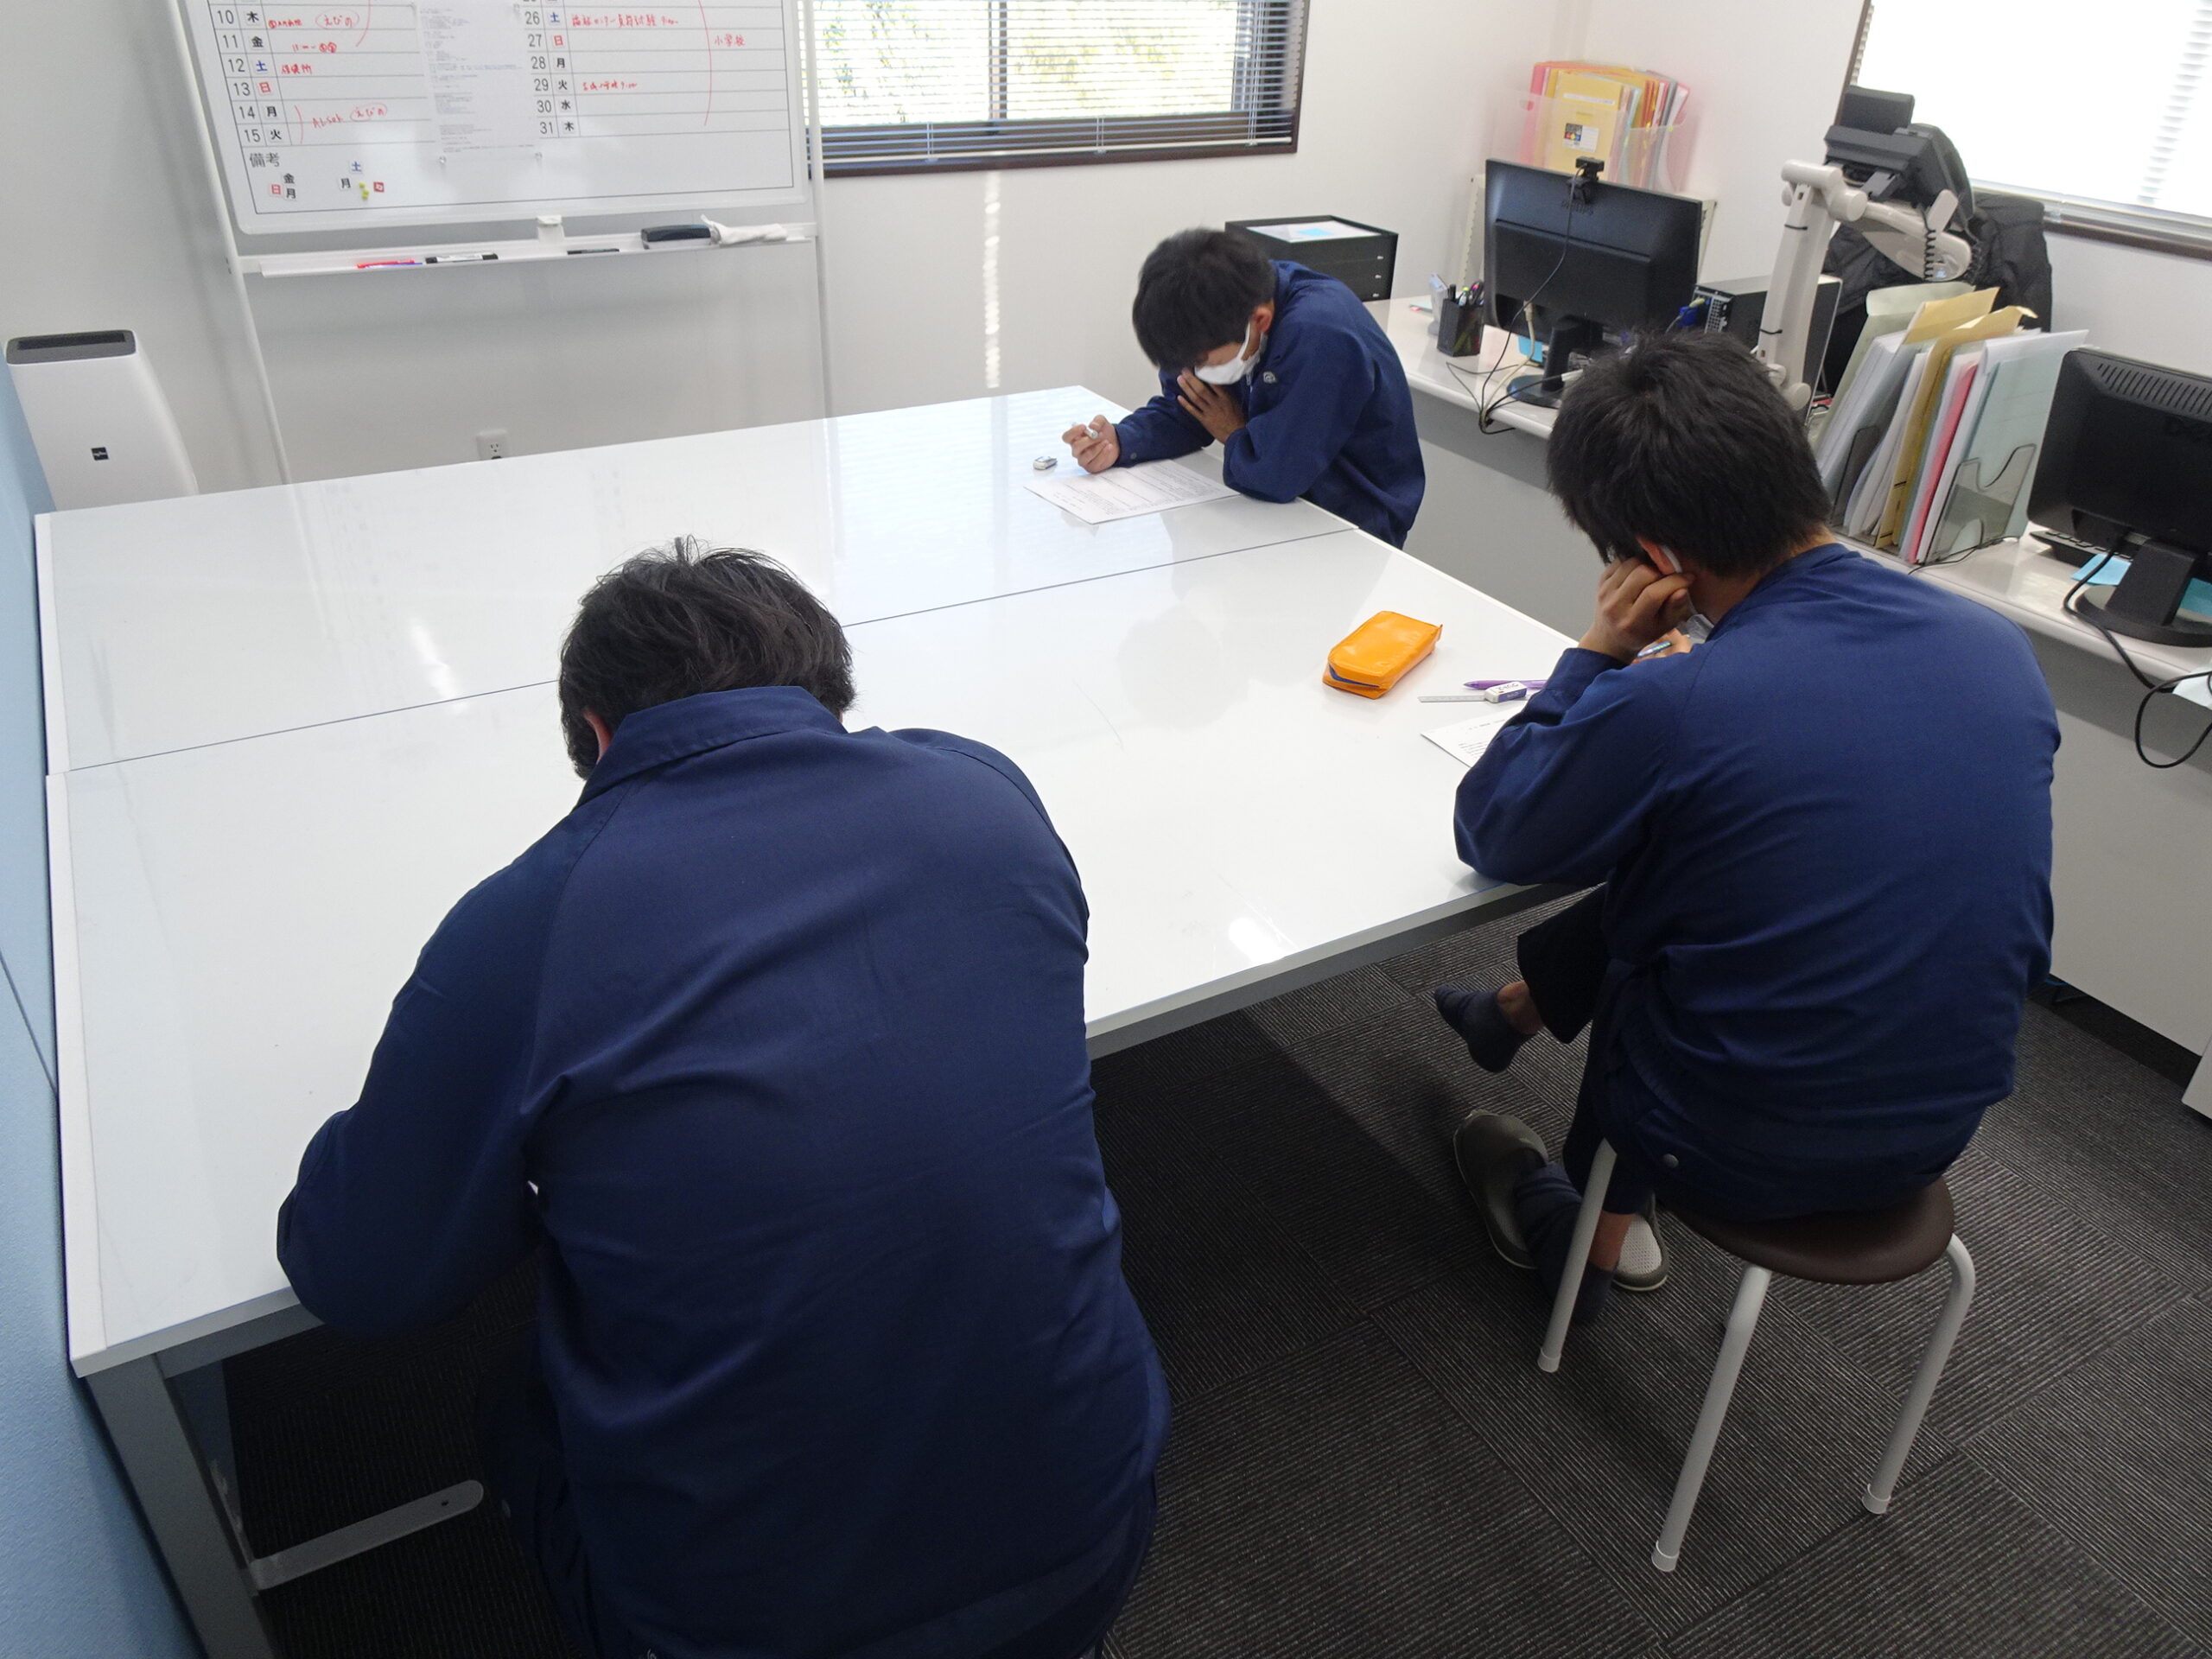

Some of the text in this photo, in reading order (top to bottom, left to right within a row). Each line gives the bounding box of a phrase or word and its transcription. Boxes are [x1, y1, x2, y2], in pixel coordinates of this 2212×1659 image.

[217, 9, 259, 25] 10 木
[524, 10, 540, 26] 26
[550, 12, 560, 23] 土
[222, 34, 264, 48] 11 金
[527, 34, 563, 48] 27 日
[227, 58, 268, 73] 12 土
[531, 55, 547, 70] 28
[556, 57, 566, 69] 月
[233, 81, 271, 97] 13 日
[533, 78, 550, 92] 29
[558, 79, 568, 91] 火
[238, 105, 277, 119] 14 月
[537, 99, 571, 113] 30 水
[539, 121, 575, 135] 31 木
[244, 128, 283, 143] 15 火
[249, 152, 280, 168] 備考
[352, 161, 362, 172] 土
[283, 173, 295, 184] 金
[340, 177, 352, 189] 月
[270, 184, 282, 195] 日
[286, 188, 296, 200] 月
